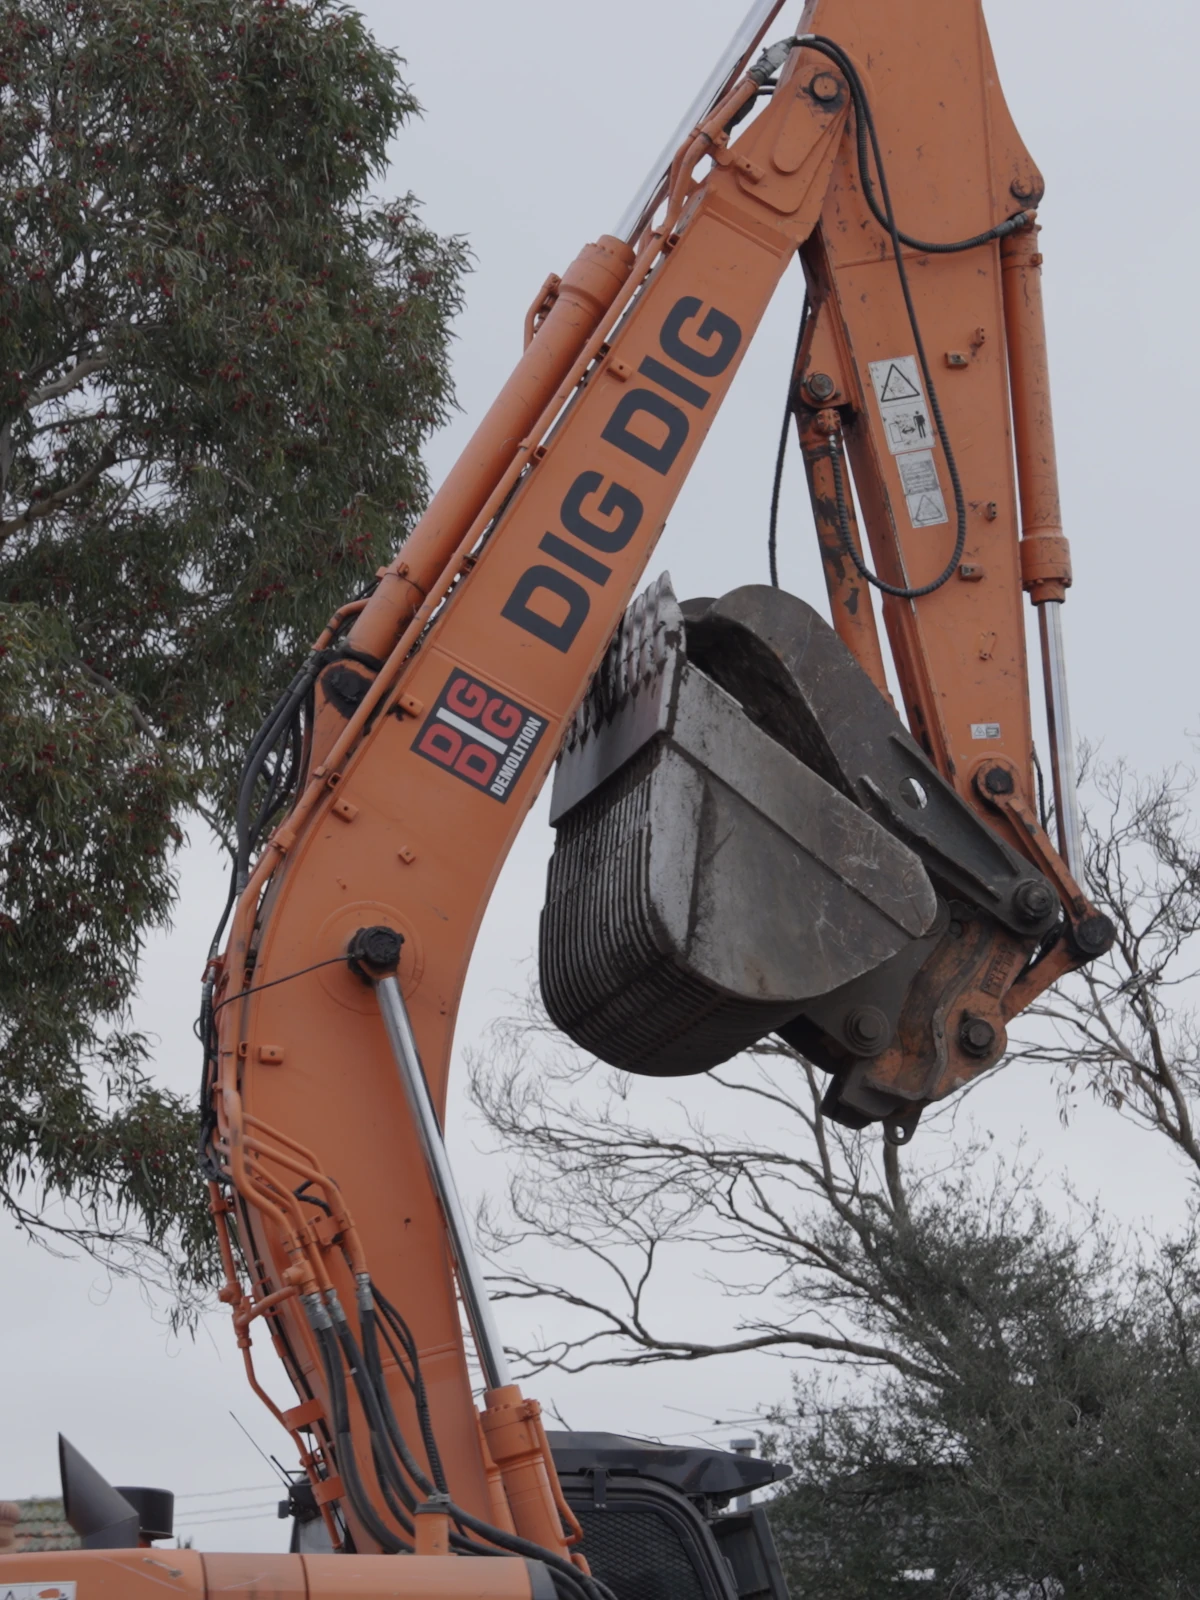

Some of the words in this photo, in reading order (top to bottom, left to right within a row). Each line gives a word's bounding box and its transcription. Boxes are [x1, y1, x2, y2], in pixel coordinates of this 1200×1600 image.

[500, 470, 644, 654] DIG
[600, 295, 742, 476] DIG
[490, 716, 542, 797] DEMOLITION
